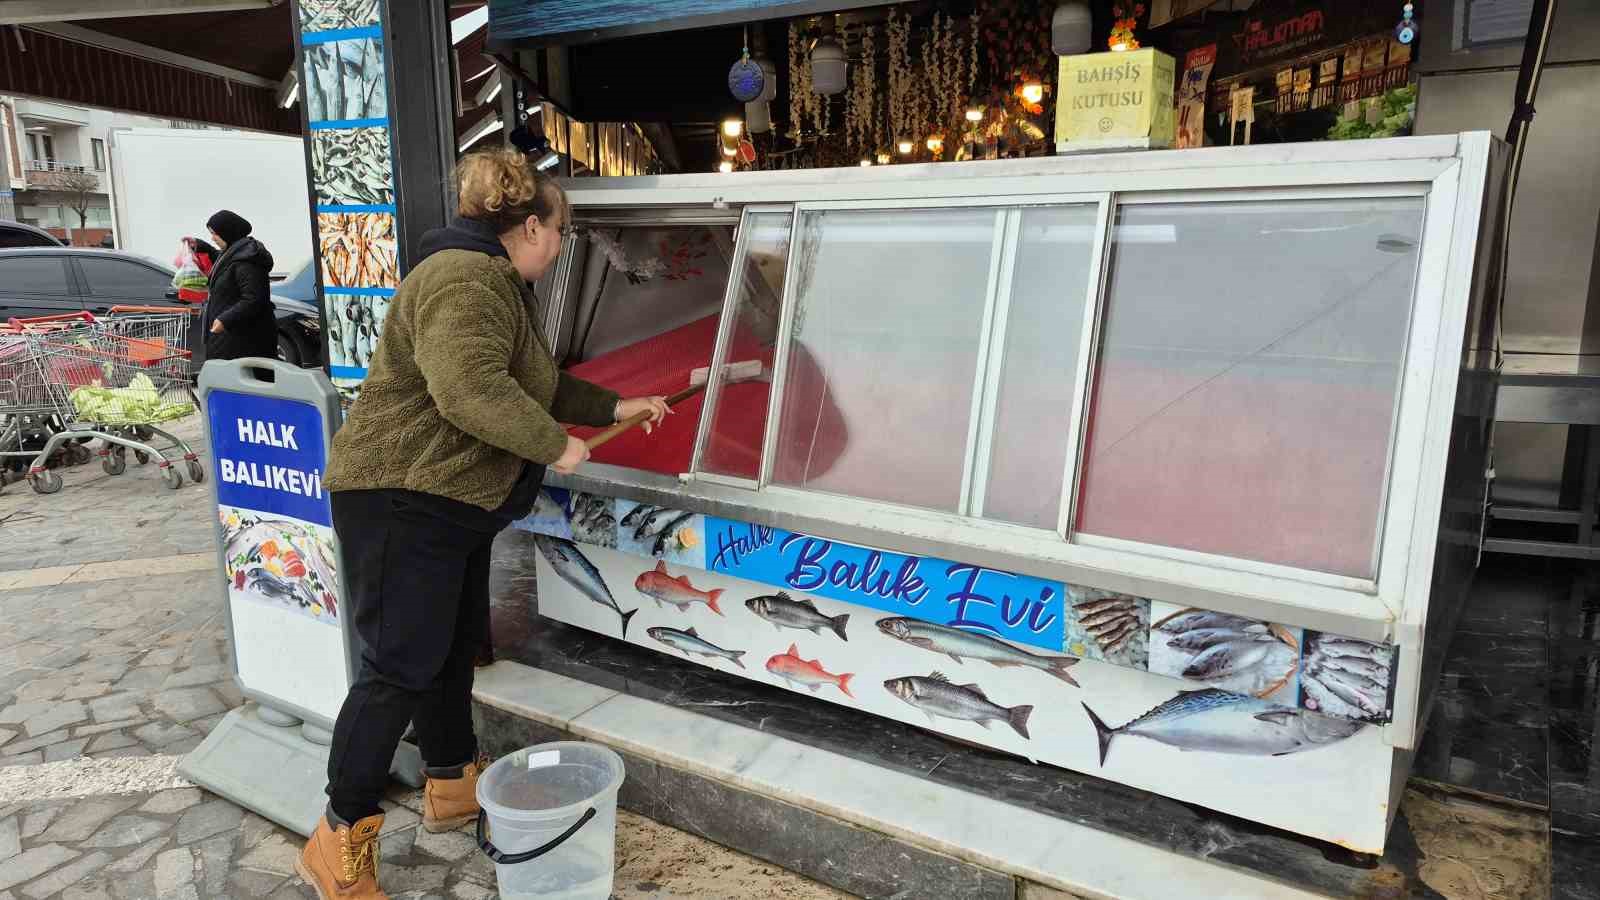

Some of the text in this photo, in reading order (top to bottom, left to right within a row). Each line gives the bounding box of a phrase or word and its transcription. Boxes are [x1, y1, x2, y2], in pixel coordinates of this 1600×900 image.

[1077, 60, 1142, 84] BAHŞİŞ
[1072, 90, 1144, 111] KUTUSU
[237, 417, 298, 450] HALK
[220, 458, 321, 499] BALIKEVİ
[712, 522, 1058, 637] Halk Balık Evi
